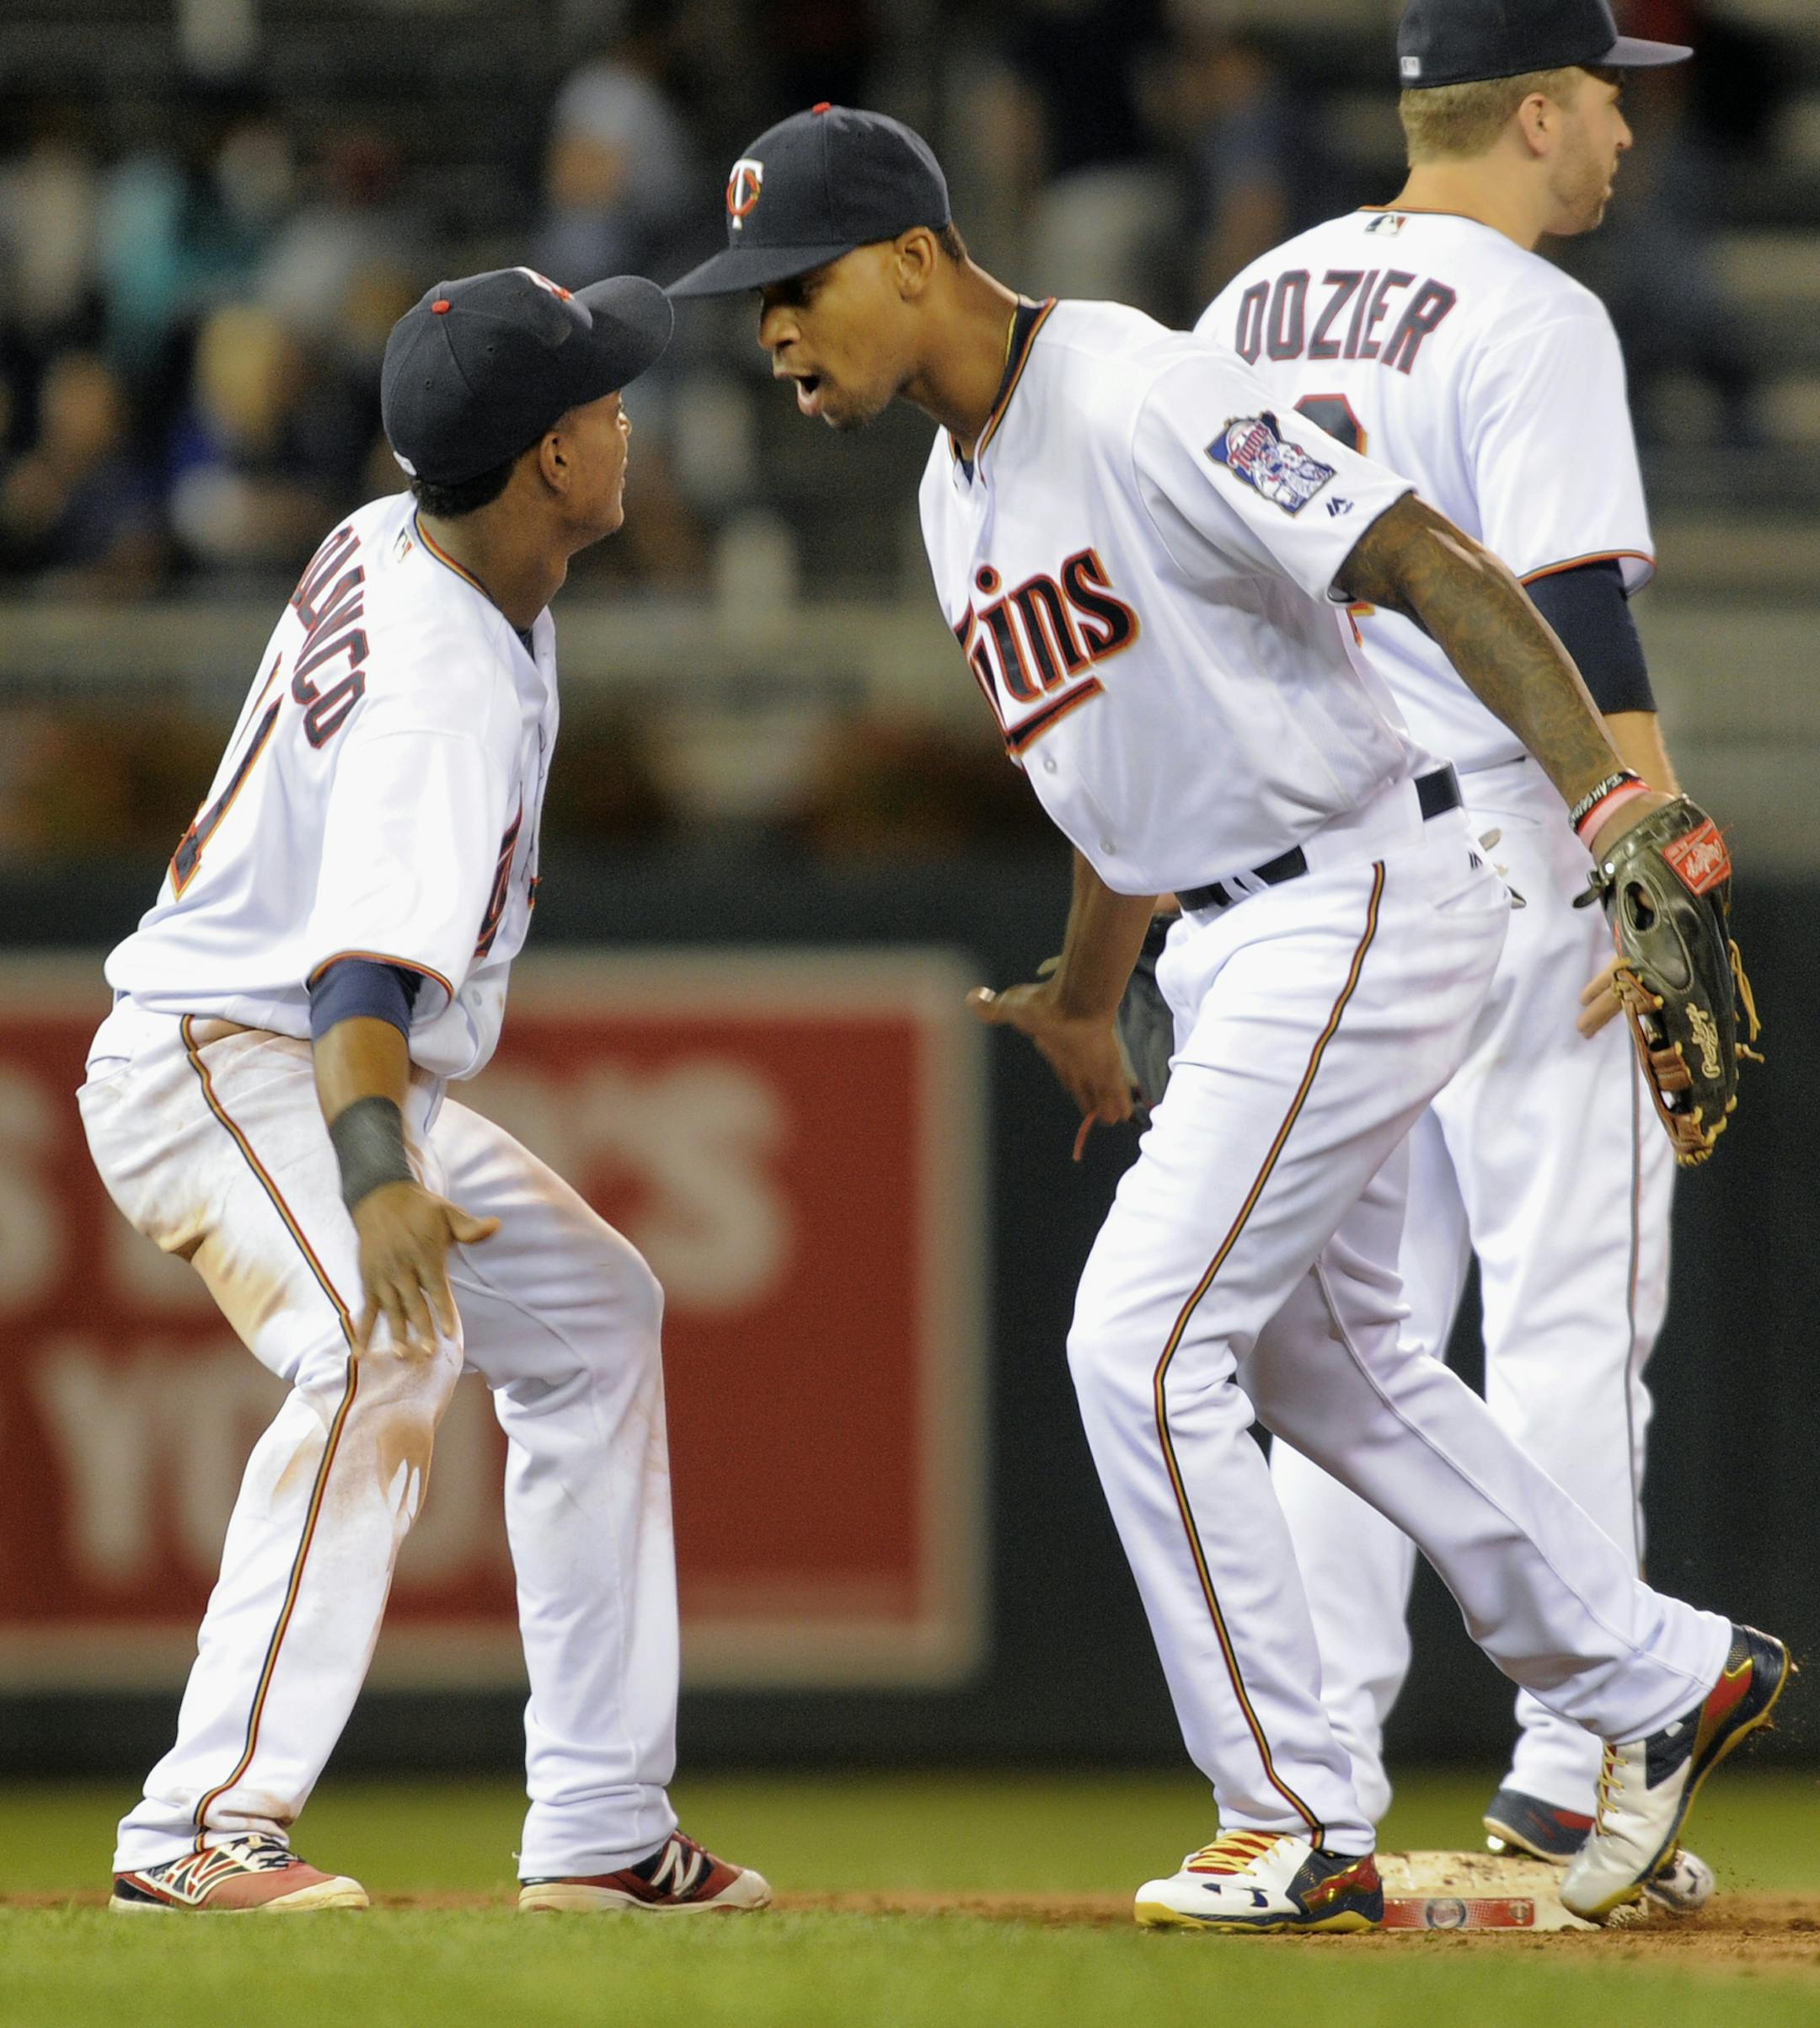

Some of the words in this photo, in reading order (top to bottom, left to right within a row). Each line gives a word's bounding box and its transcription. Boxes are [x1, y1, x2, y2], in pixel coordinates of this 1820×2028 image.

[1235, 269, 1457, 375] DOZIER
[288, 524, 370, 750] OLANCO
[953, 547, 1141, 735] ins
